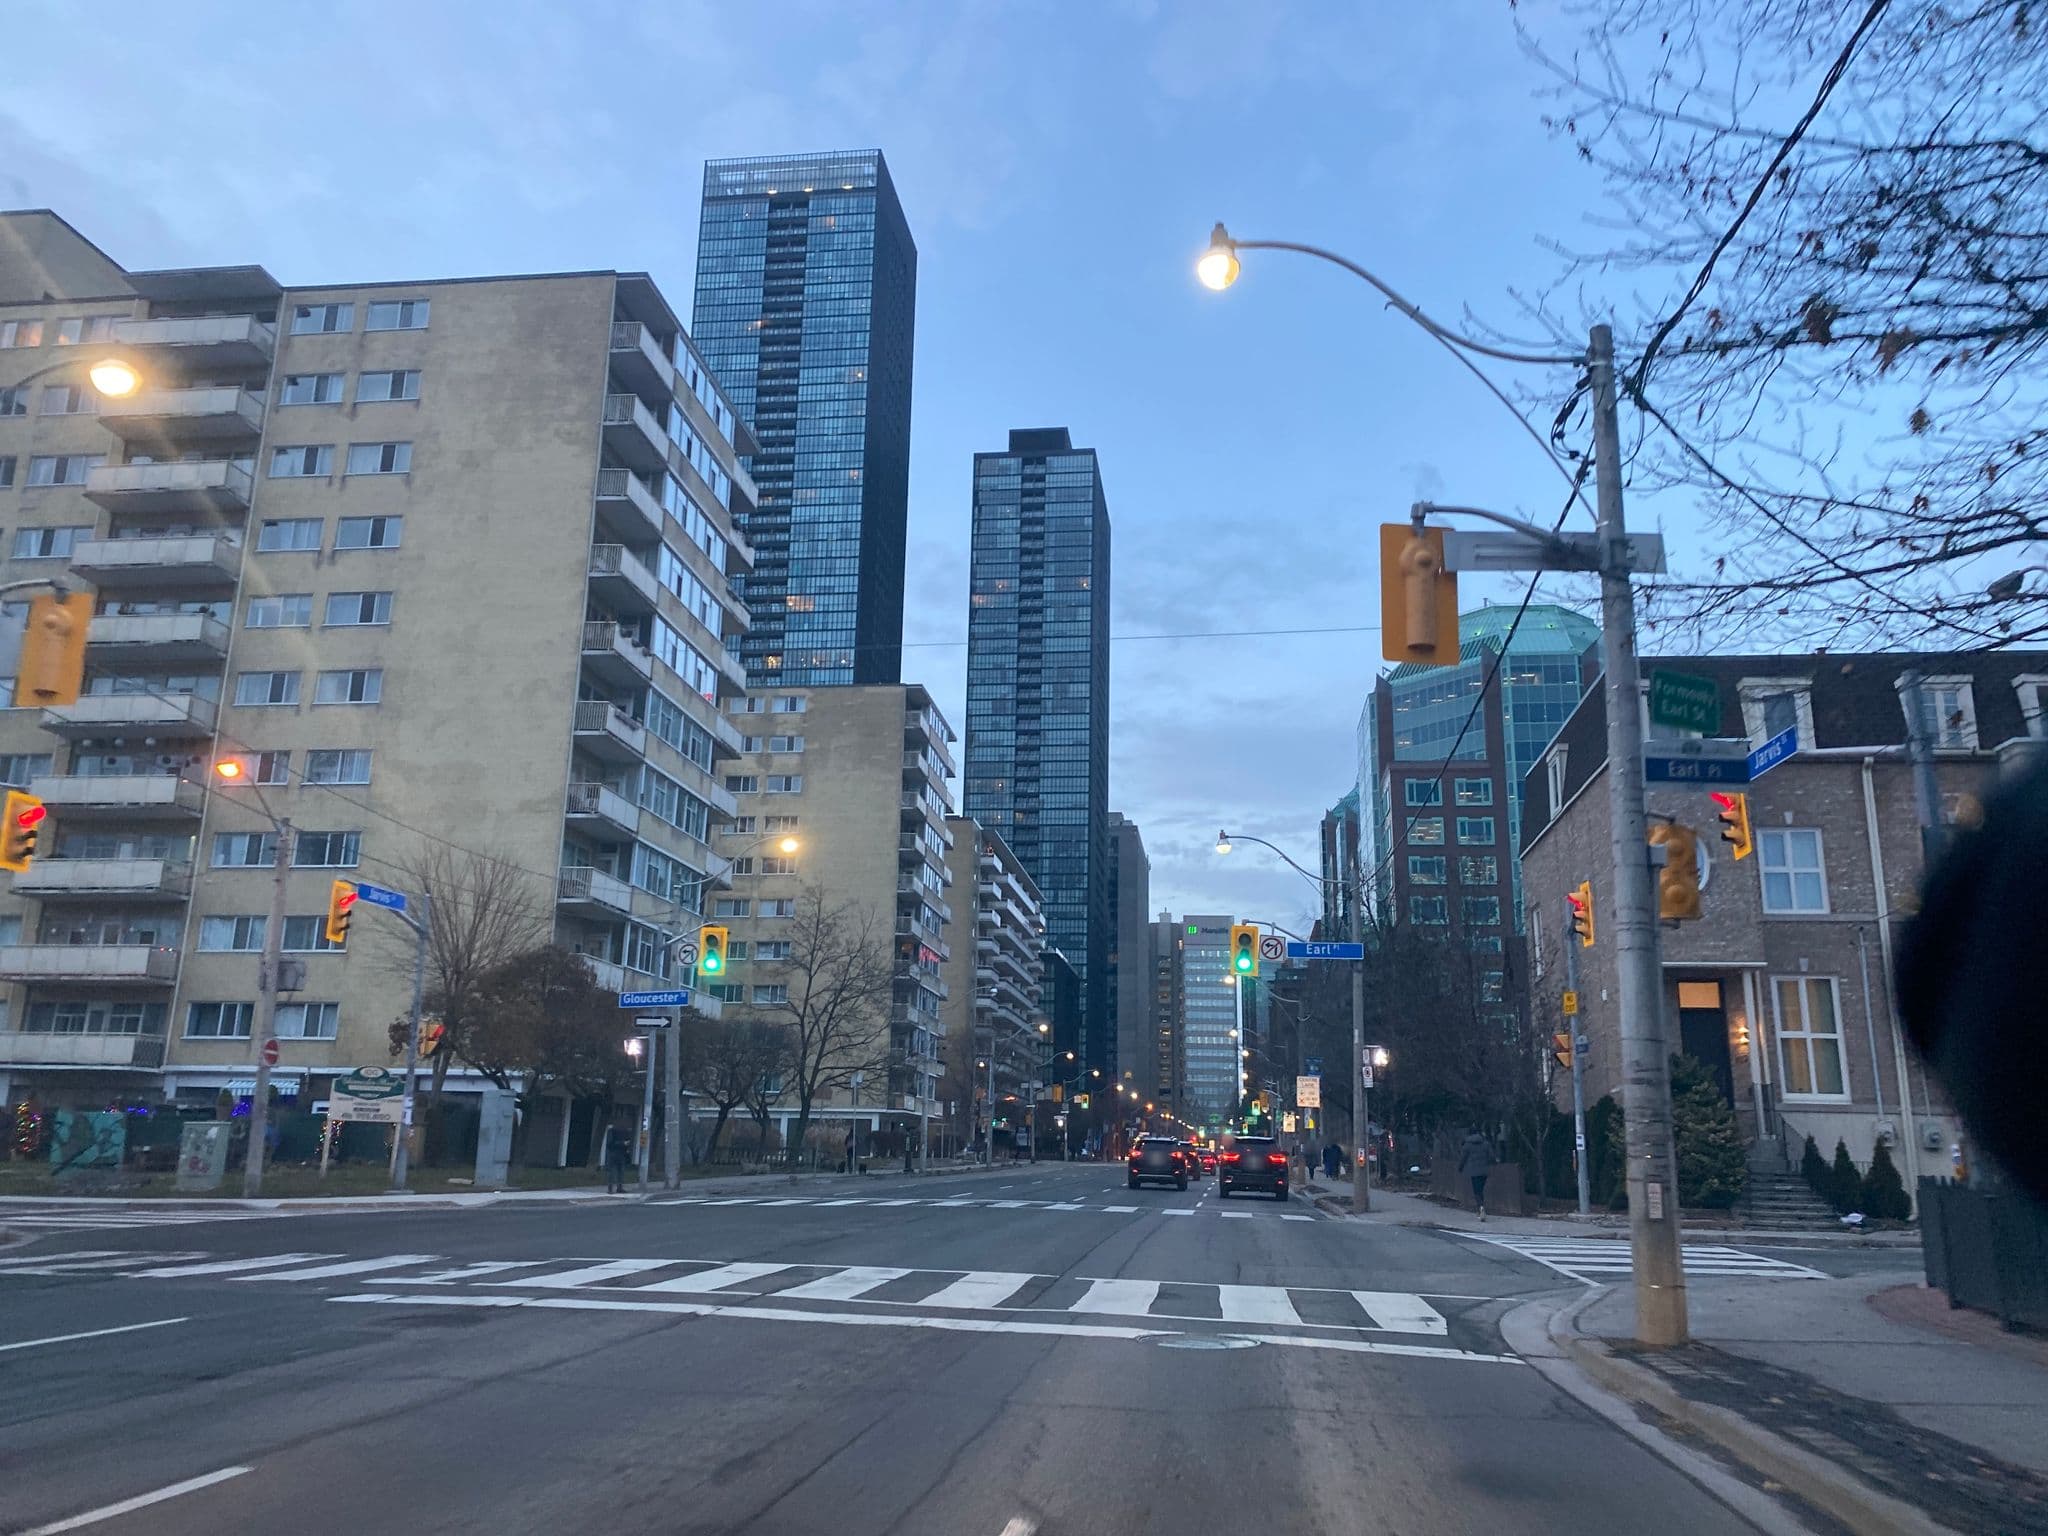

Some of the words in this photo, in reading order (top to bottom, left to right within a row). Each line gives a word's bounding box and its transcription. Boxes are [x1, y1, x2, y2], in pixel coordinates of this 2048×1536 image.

[1754, 741, 1782, 769] Jarvis
[1668, 761, 1701, 777] Earl
[1306, 944, 1331, 955] Earl
[623, 993, 679, 1004] Gloucester
